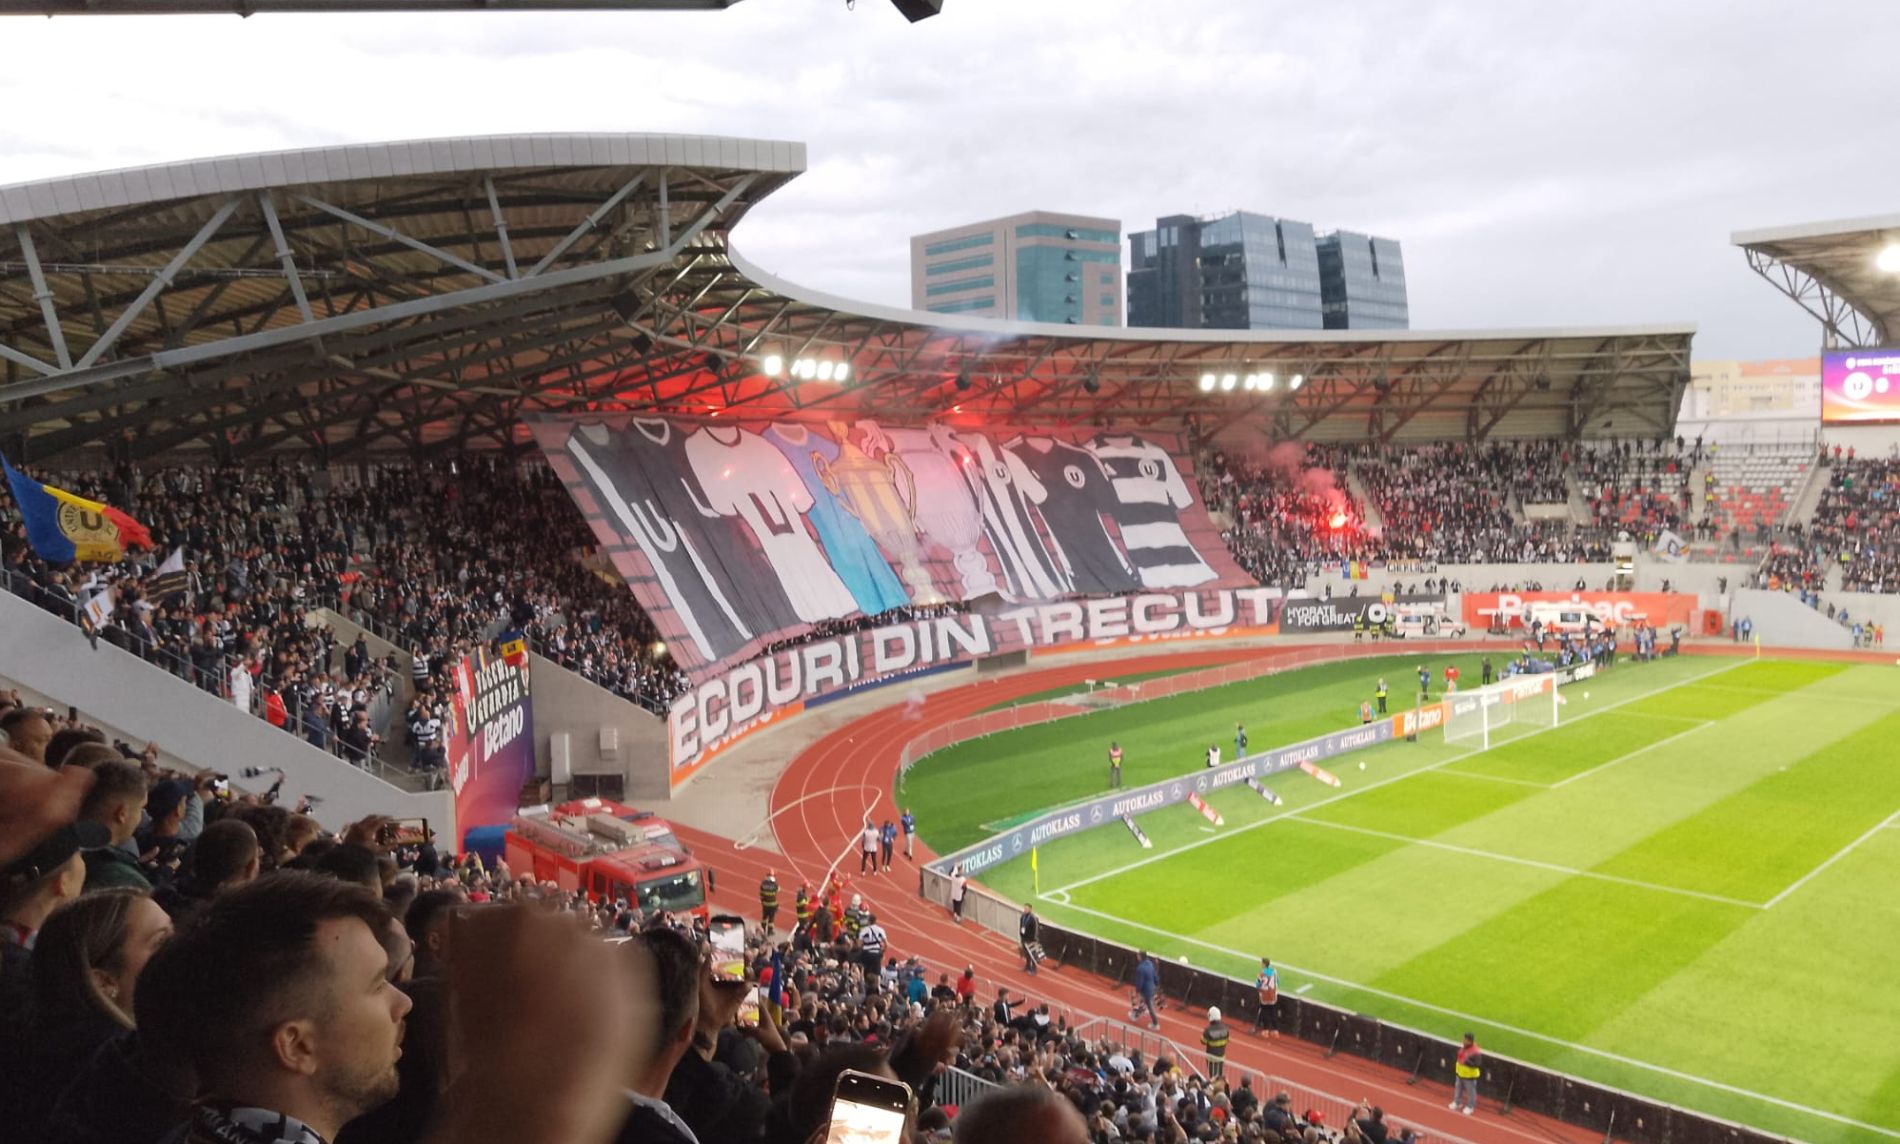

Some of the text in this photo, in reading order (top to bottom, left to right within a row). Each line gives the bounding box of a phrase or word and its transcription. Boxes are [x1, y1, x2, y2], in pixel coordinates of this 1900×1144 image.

[1287, 605, 1336, 619] HYDRATE
[671, 634, 859, 767] ECOURI
[873, 614, 991, 673] DIN
[999, 587, 1283, 646] TRECUT
[484, 704, 524, 763] Betano
[1340, 728, 1376, 750] AUTOKLASS
[1279, 745, 1319, 768] AUTOKLASS
[1212, 762, 1256, 787] AUTOKLASS
[1112, 790, 1164, 817] AUTOKLASS
[1030, 813, 1081, 845] AUTOKLASS
